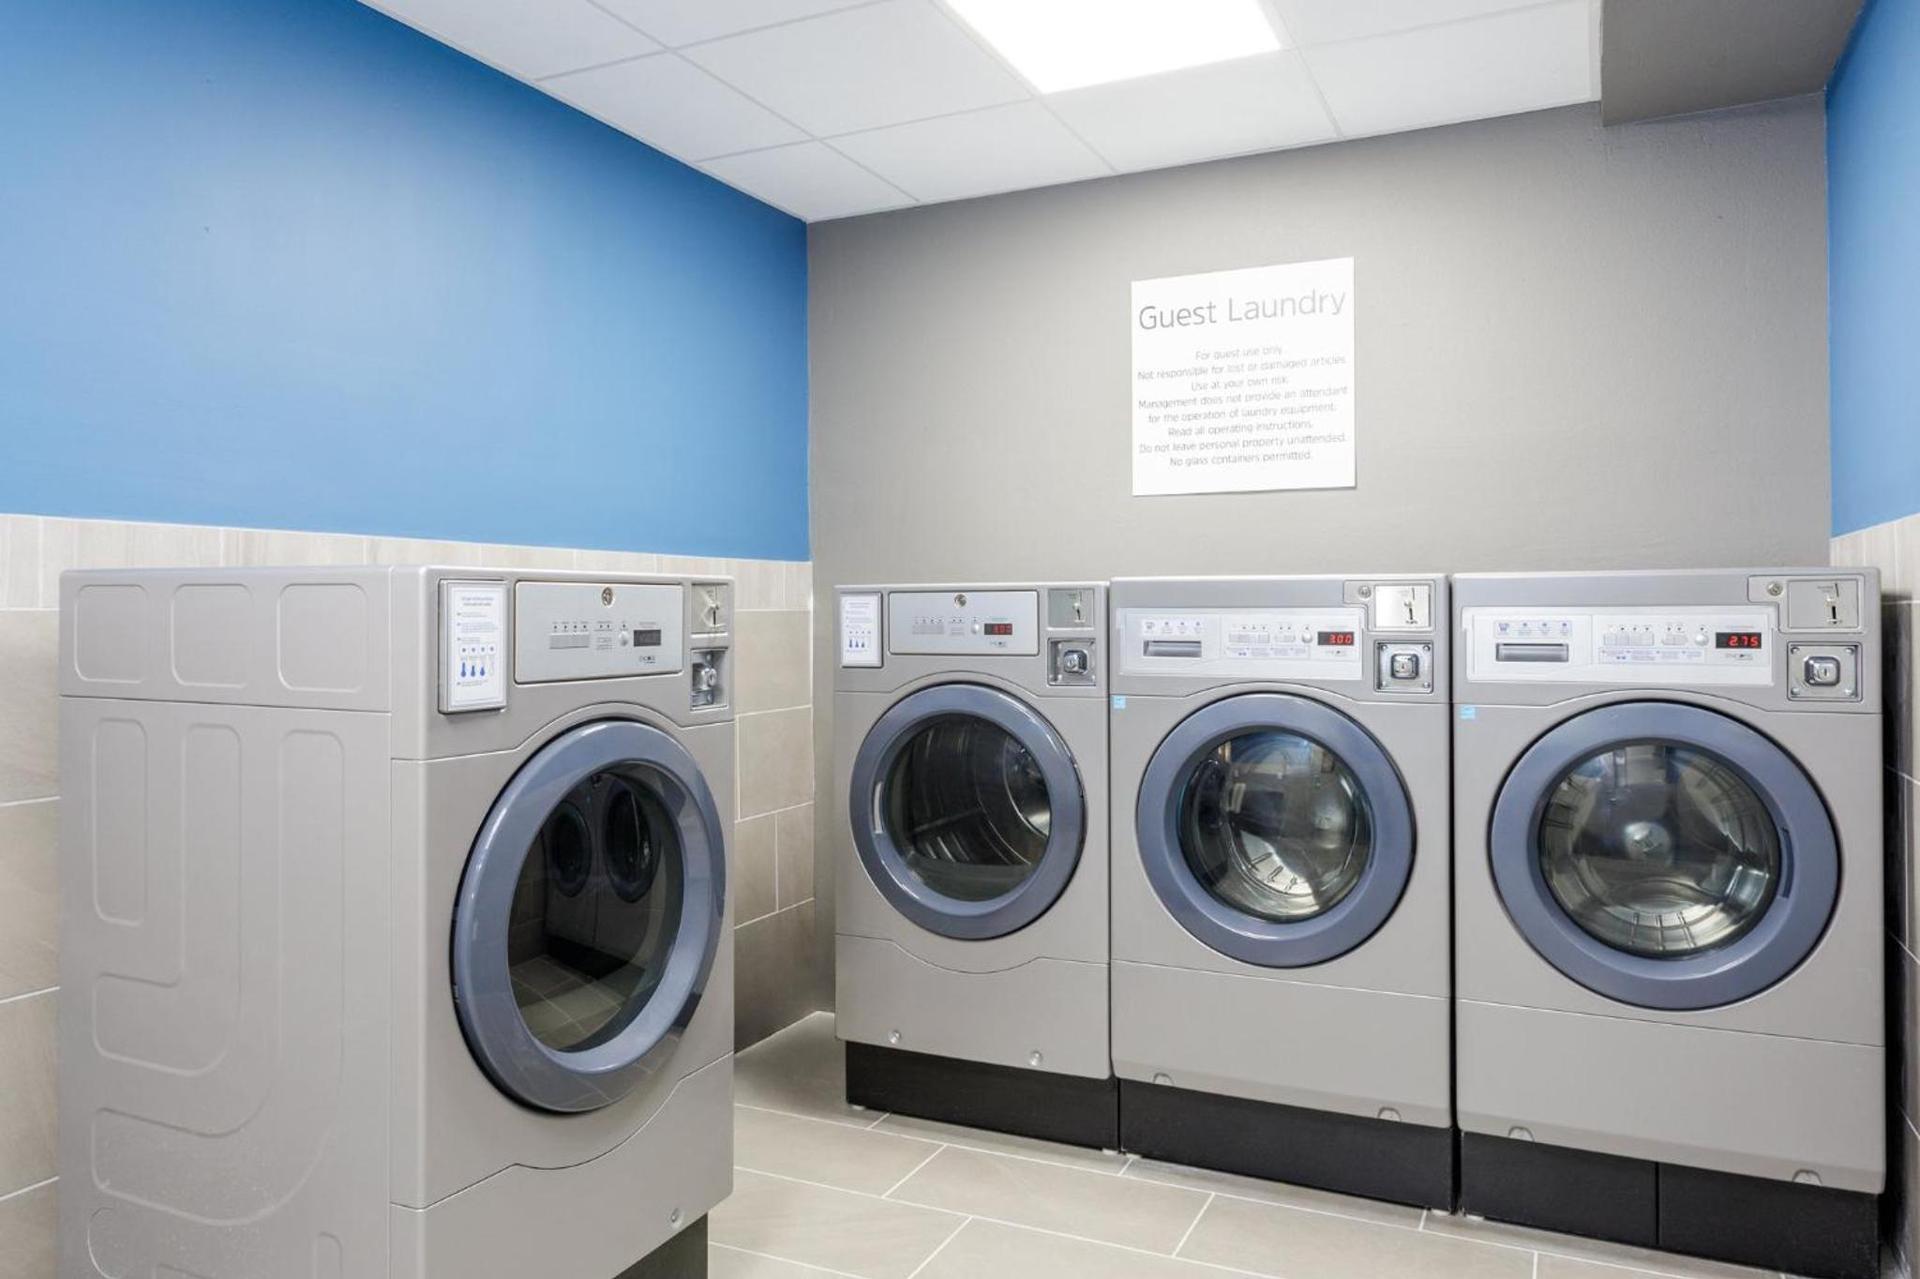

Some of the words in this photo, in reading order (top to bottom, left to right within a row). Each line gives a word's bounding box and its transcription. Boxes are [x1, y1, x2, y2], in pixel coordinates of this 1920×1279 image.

[1138, 301, 1217, 330] Guest
[1228, 288, 1346, 323] Laundry
[1195, 350, 1211, 361] For
[1214, 348, 1240, 361] guest
[1243, 348, 1260, 357] use
[1137, 371, 1154, 380] Not
[1156, 366, 1208, 379] responsible
[1211, 365, 1225, 374] for
[1247, 362, 1258, 371] or
[1260, 357, 1308, 371] damaged
[1191, 381, 1209, 392] Use
[1210, 380, 1220, 390] at
[1223, 379, 1244, 390] your
[1247, 376, 1268, 387] own
[1138, 396, 1198, 410] Management
[1200, 396, 1224, 406] does
[1226, 394, 1242, 404] not
[1245, 391, 1281, 403] provide
[1284, 390, 1298, 400] an
[1300, 386, 1348, 399] attendant
[1148, 414, 1161, 424] for
[1163, 413, 1179, 423] the
[1181, 410, 1226, 423] operation
[1229, 408, 1240, 418] of
[1242, 406, 1278, 418] laundry
[1168, 426, 1192, 436] Read
[1195, 425, 1206, 435] all
[1207, 423, 1253, 435] operating
[1139, 443, 1153, 454] Do
[1154, 443, 1170, 453] not
[1172, 442, 1197, 452] leave
[1199, 439, 1240, 451] personal
[1242, 436, 1285, 448] property
[1170, 457, 1184, 466] No
[1185, 456, 1209, 467] glass
[1211, 453, 1260, 465] containers
